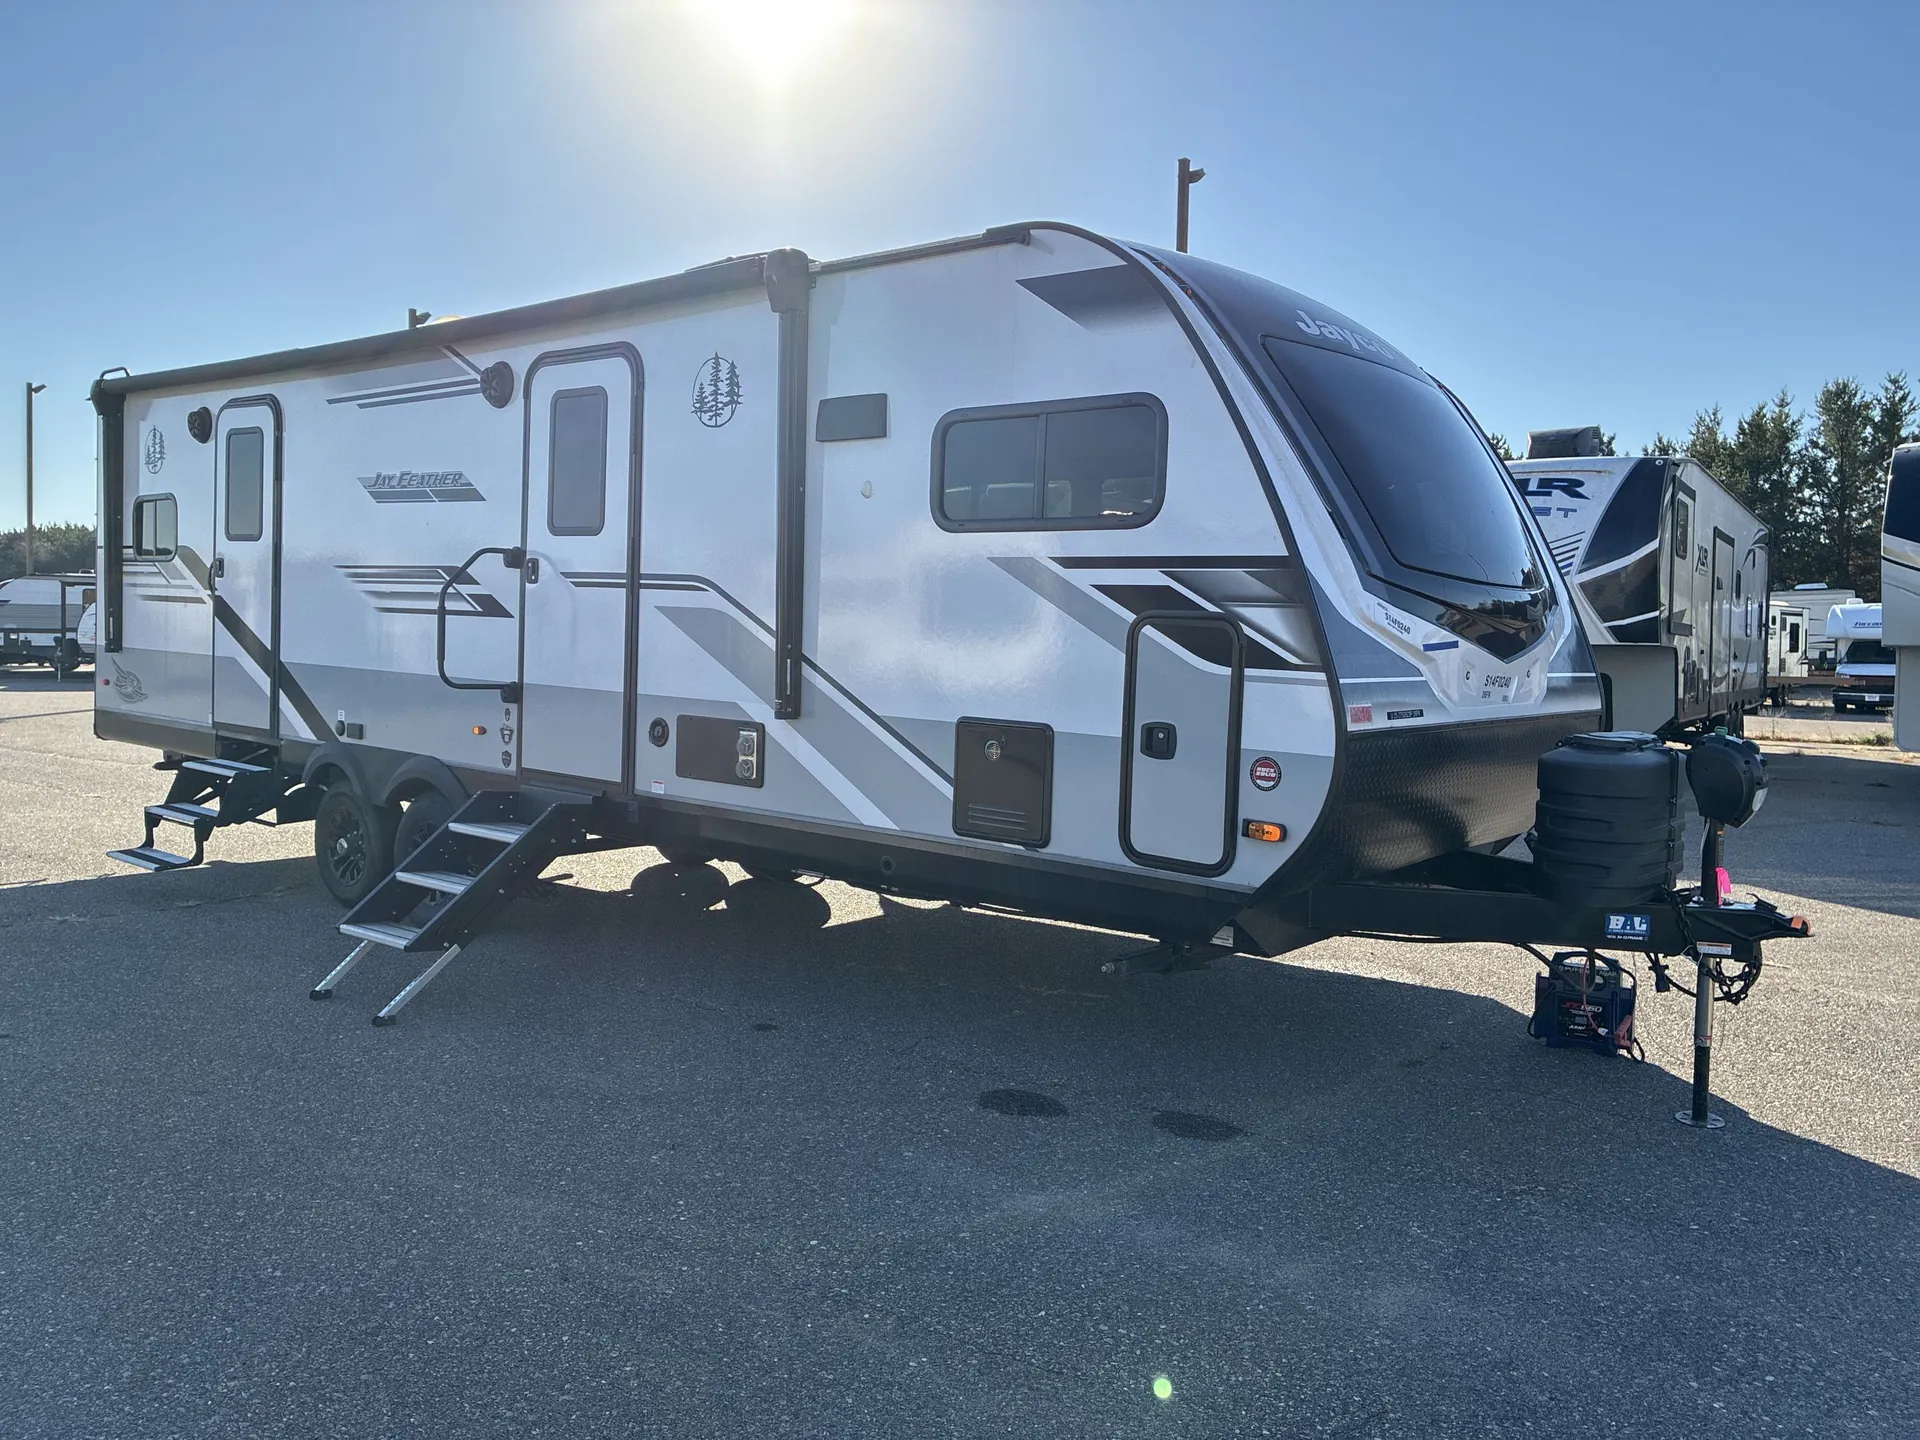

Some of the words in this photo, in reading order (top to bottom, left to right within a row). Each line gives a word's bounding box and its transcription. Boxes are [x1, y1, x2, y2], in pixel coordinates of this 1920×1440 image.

[1296, 309, 1395, 360] Jayco
[367, 472, 397, 488] JAY
[397, 470, 463, 487] FEATHER
[1516, 478, 1591, 500] LR
[1695, 543, 1708, 572] XLR
[1384, 612, 1410, 634] S14F0240
[1484, 674, 1511, 688] S14F0240
[1608, 915, 1647, 931] BAL
